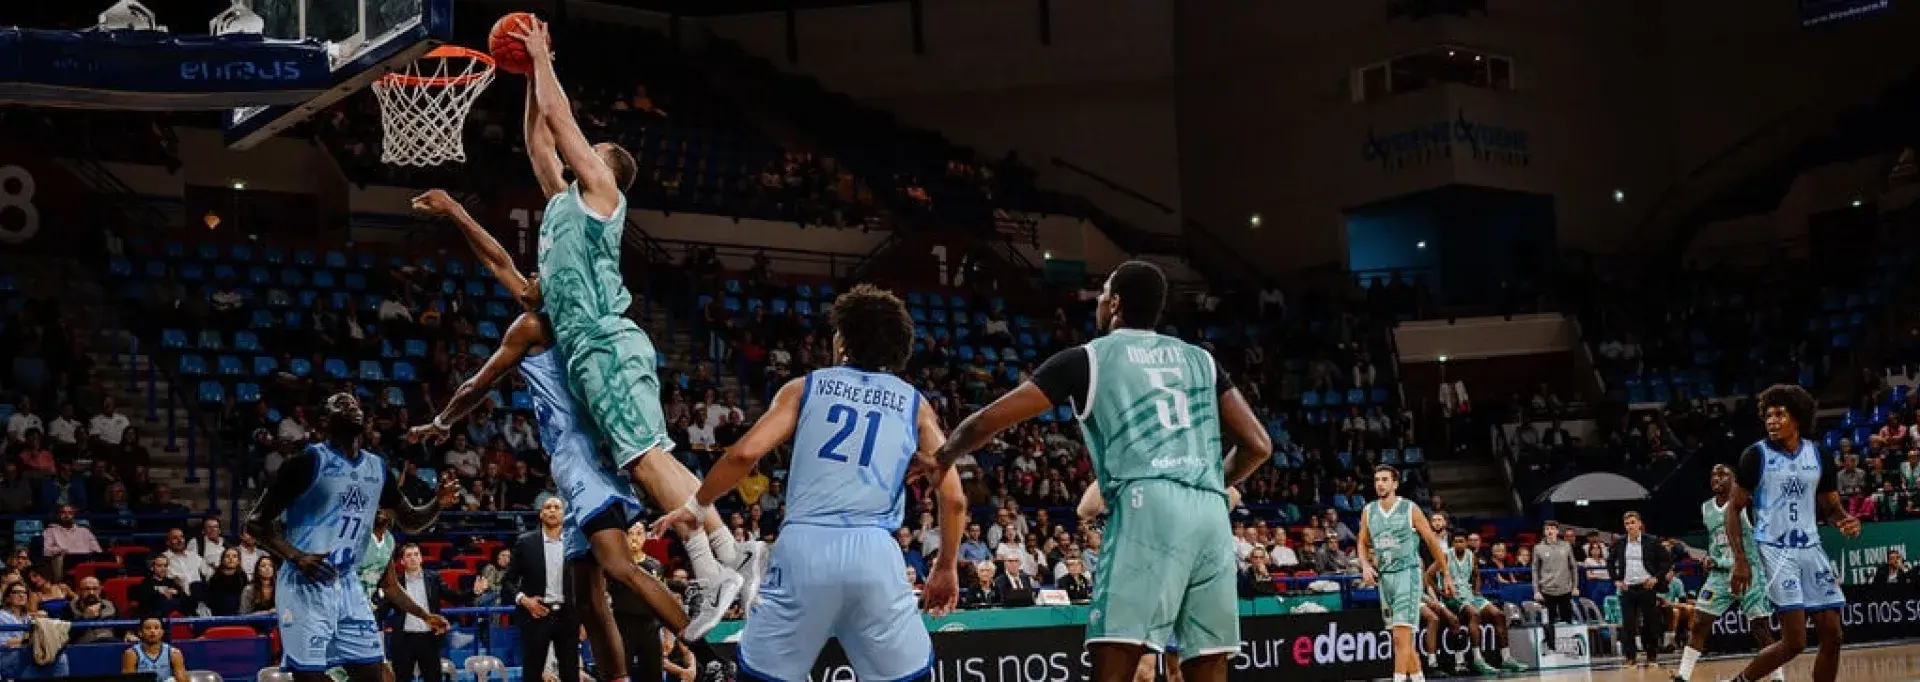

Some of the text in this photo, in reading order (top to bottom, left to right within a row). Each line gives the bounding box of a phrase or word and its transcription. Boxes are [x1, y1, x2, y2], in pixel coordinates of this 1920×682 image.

[863, 388, 908, 413] EBELE
[1144, 367, 1191, 430] 5
[818, 403, 882, 467] 21
[1788, 502, 1798, 523] 5
[339, 515, 361, 540] 77
[1867, 600, 1903, 624] nos
[998, 651, 1069, 682] nos
[1233, 638, 1285, 670] sur
